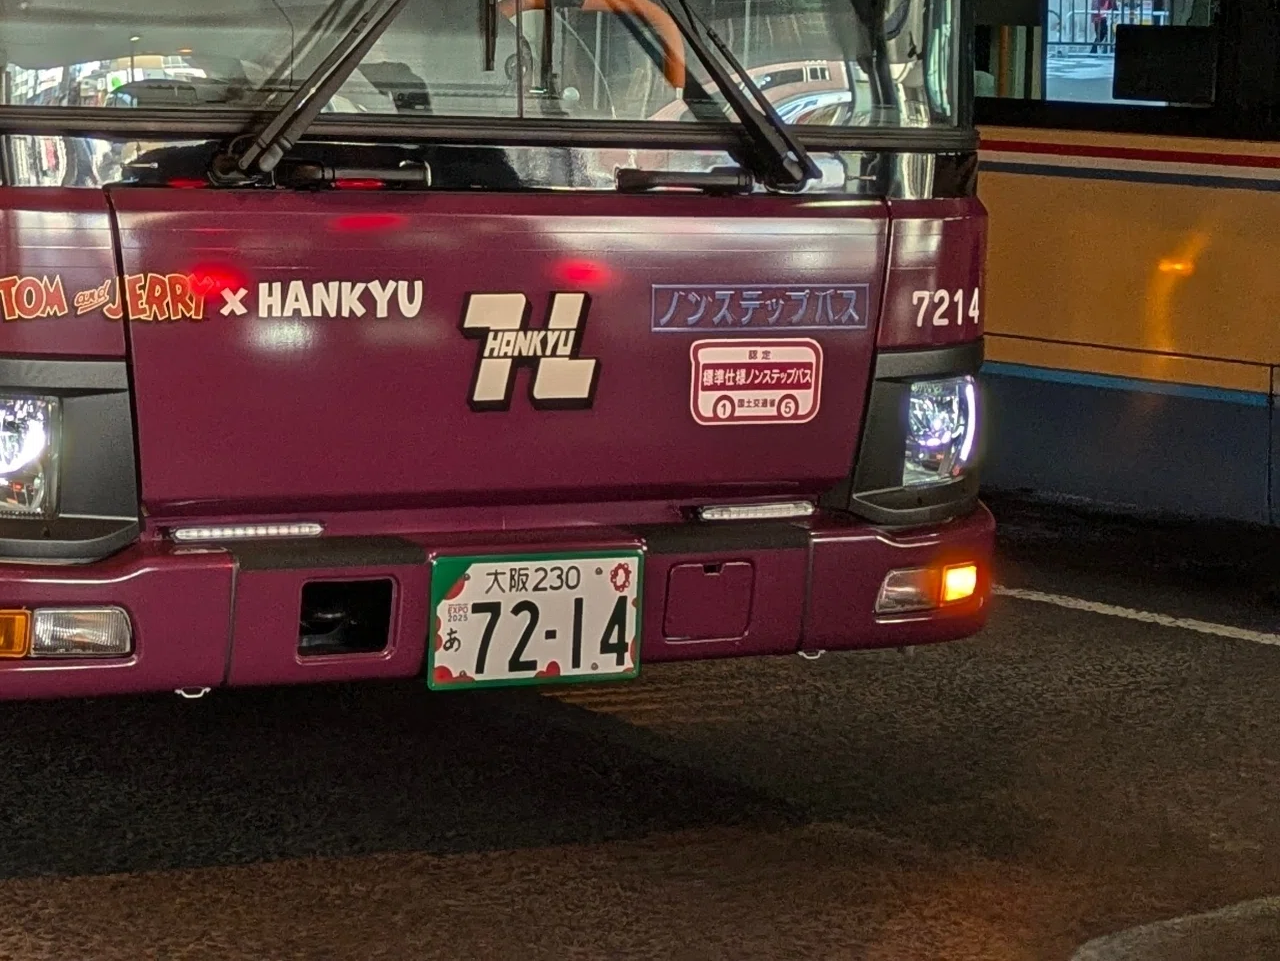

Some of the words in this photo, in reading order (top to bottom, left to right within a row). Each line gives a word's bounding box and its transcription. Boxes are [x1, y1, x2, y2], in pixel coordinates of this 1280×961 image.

[74, 279, 111, 315] and
[103, 272, 216, 321] JERRY
[257, 279, 424, 319] HANKYU
[658, 288, 860, 326] ノンステップバス
[911, 287, 980, 327] 7214
[483, 329, 576, 359] HANKYU
[747, 349, 772, 360] 認定
[702, 367, 812, 387] 標準仕様ノンステップバス
[720, 402, 727, 416] 1
[783, 401, 792, 415] 5
[447, 606, 469, 614] EXPO
[447, 614, 469, 622] 2025
[443, 627, 461, 652] あ
[470, 595, 629, 675] 72-14
